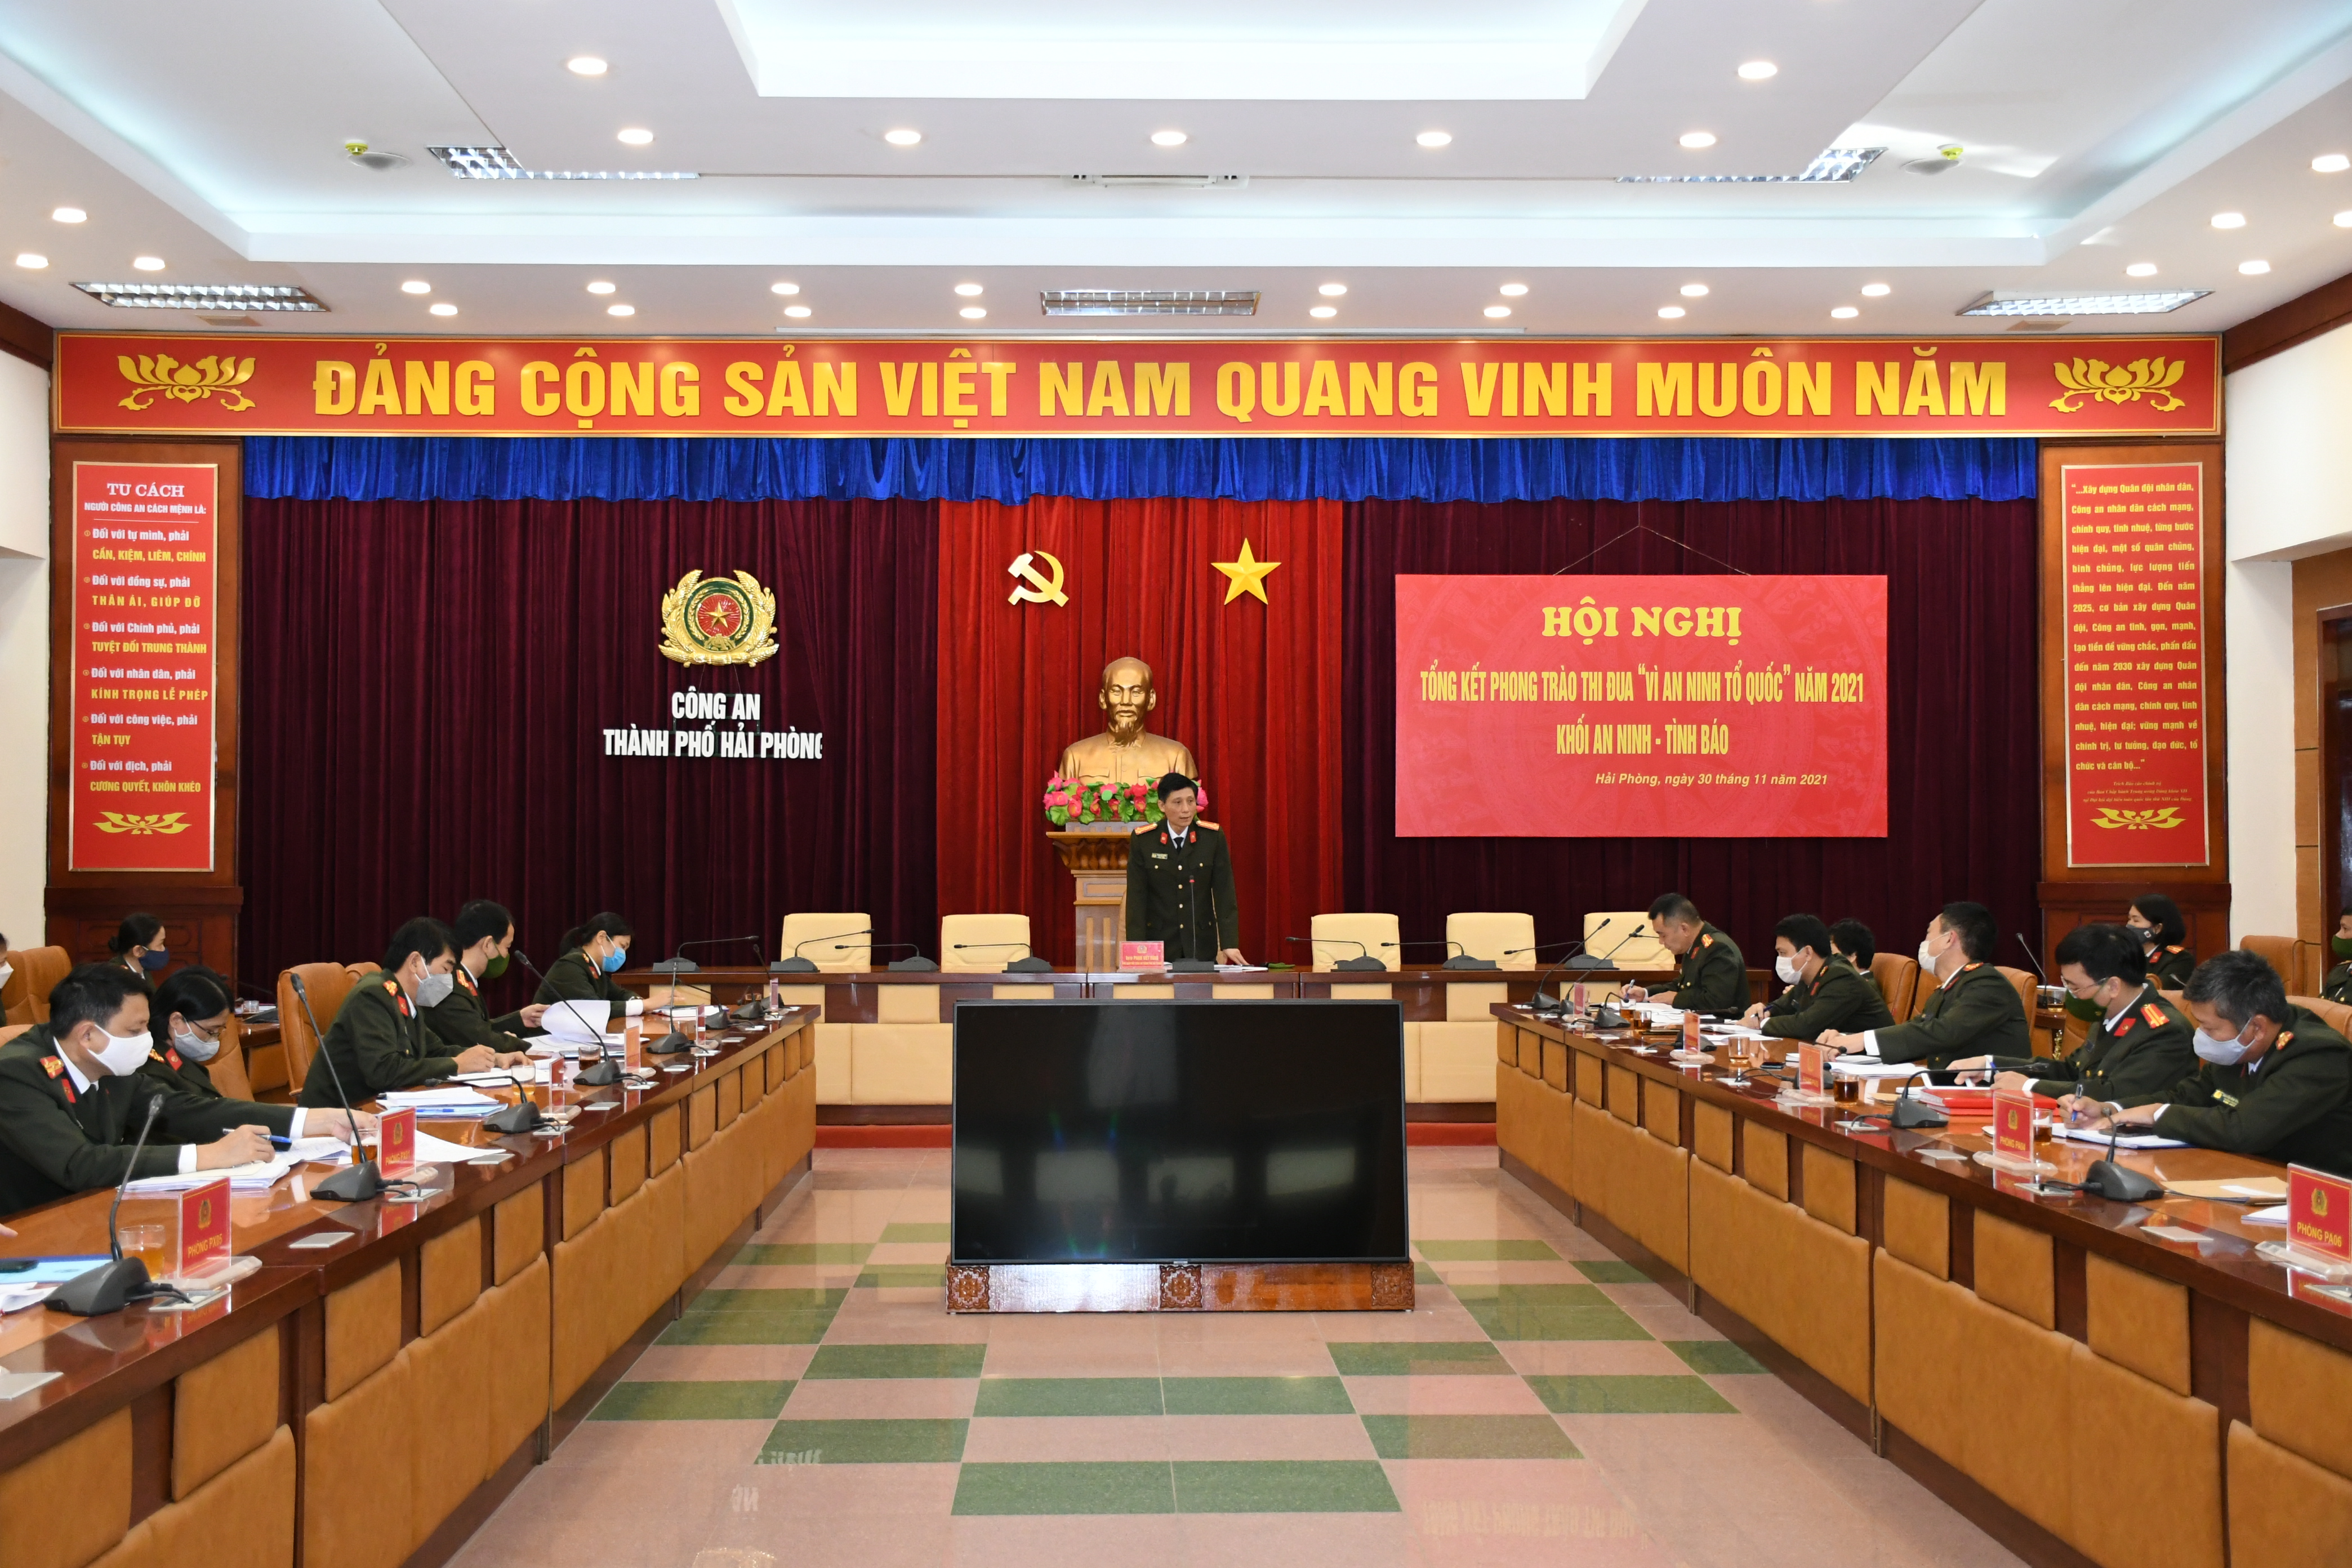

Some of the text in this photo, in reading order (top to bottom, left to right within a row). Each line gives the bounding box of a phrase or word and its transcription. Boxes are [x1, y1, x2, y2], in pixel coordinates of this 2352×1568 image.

[313, 344, 2006, 429] ĐẢNG CỘNG SẢN VIỆT NAM QUANG VINH MUÔN NĂM
[136, 482, 185, 497] CÁCH
[111, 502, 132, 512] CÔNG
[147, 504, 168, 513] CÁCH
[170, 504, 193, 515] MỆNH
[93, 528, 108, 538] Đối
[111, 529, 125, 539] với
[128, 530, 137, 541] tự
[169, 531, 189, 541] phải
[118, 549, 145, 562] KIỆM,
[148, 550, 173, 562] LIÊM,
[177, 550, 206, 562] CHÍNH
[92, 574, 108, 585] Đối
[111, 576, 124, 585] với
[170, 577, 190, 588] phải
[92, 594, 124, 605] THÂN
[130, 595, 146, 607] ÁI,
[151, 595, 180, 607] GIÚP
[92, 621, 108, 631] Đối
[110, 623, 124, 632] với
[127, 623, 154, 632] Chính
[180, 623, 199, 634] phải
[1542, 596, 1741, 645] HỘI NGHỊ
[92, 640, 206, 653] TUYỆT ĐỐI TRUNG THÀNH
[92, 667, 106, 678] Đối
[110, 669, 124, 678] với
[127, 669, 149, 678] nhân
[153, 669, 172, 680] dân,
[175, 669, 195, 680] phải
[1420, 659, 1456, 701] TỔNG
[1462, 662, 1486, 701] KẾT
[1491, 671, 1537, 701] PHONG
[1542, 665, 1576, 701] TRÀO
[1581, 672, 1602, 701] THI
[1606, 672, 1633, 701] ĐUA
[1663, 672, 1682, 701] AN
[1687, 672, 1721, 701] NINH
[1725, 660, 1742, 701] TỔ
[1796, 666, 1827, 702] NĂM
[1832, 673, 1863, 702] 2021
[92, 688, 118, 698] KÍNH
[123, 690, 159, 701] TRỌNG
[179, 689, 208, 700] PHÉP
[672, 686, 760, 720] CÔNG AN
[91, 712, 106, 723] Đối
[109, 714, 123, 724] với
[126, 714, 149, 725] công
[152, 715, 174, 726] việc,
[177, 714, 197, 725] phải
[92, 733, 131, 746] TẬN TỤY
[603, 724, 669, 756] THÀNH
[675, 721, 715, 757] PHỐ
[721, 722, 754, 758] HẢI
[1557, 714, 1589, 754] KHỐI
[1593, 725, 1612, 754] AN
[1618, 725, 1651, 754] NINH
[1665, 718, 1696, 754] TÌNH
[1701, 719, 1728, 754] BÁO
[90, 760, 105, 770] Đối
[109, 761, 122, 770] với
[152, 760, 172, 772] phải
[153, 781, 176, 792] KHÔN
[179, 781, 201, 792] KHÉO
[1596, 772, 1827, 787] Hải Phòng, ngày 30 tháng 11 năm 2021
[2297, 1222, 2342, 1248] PHÒNG PA06
[188, 1233, 222, 1259] PHÒNG PX05
